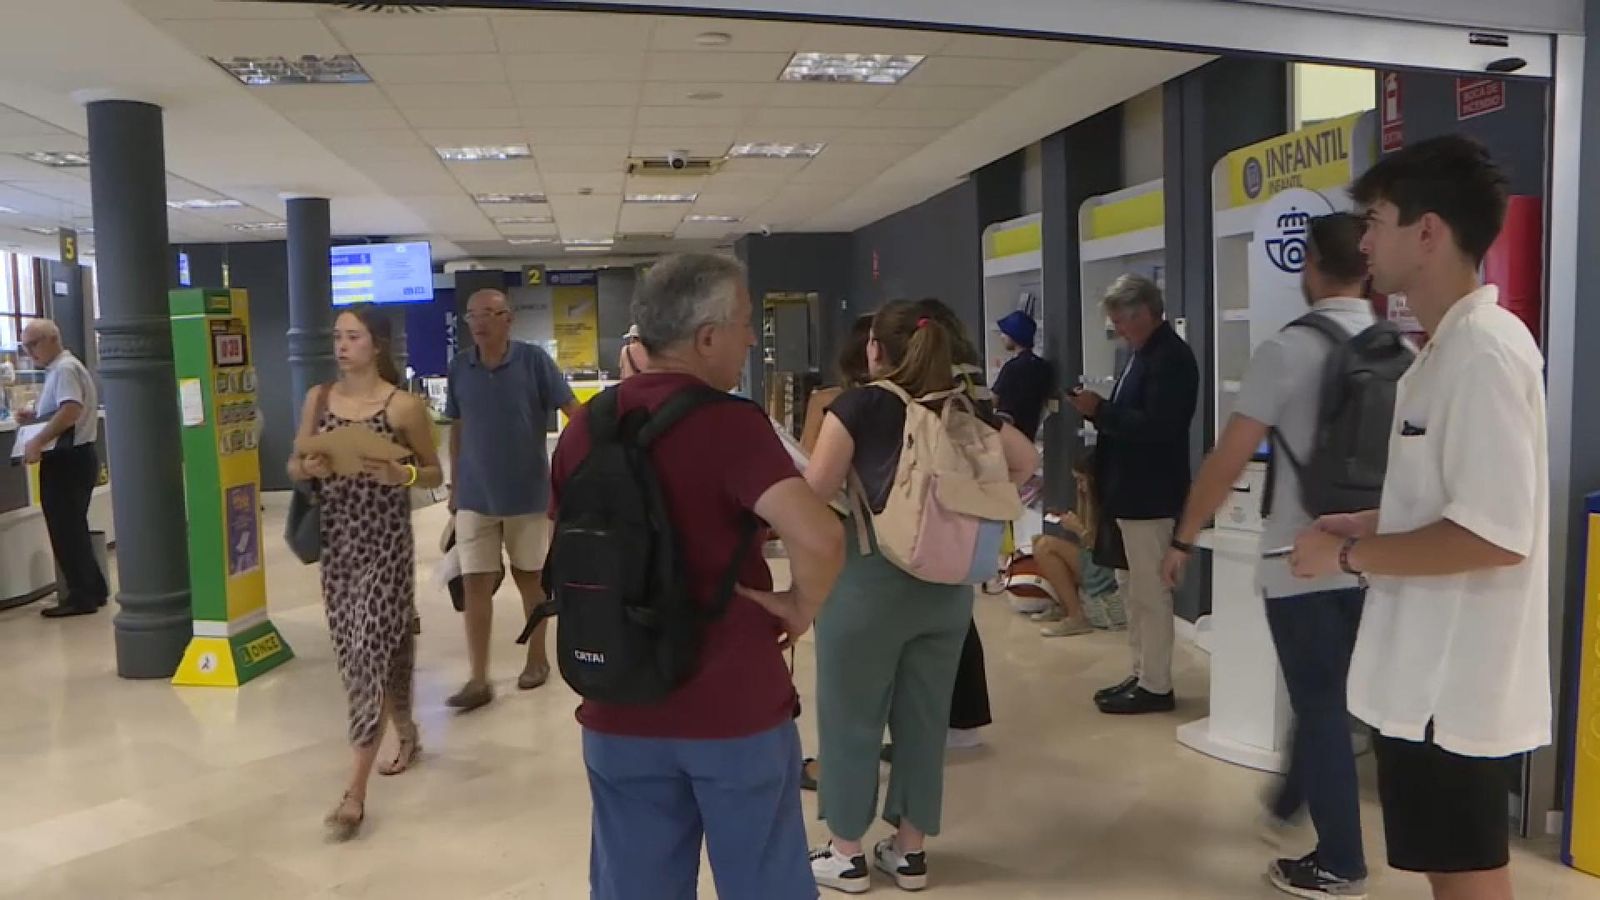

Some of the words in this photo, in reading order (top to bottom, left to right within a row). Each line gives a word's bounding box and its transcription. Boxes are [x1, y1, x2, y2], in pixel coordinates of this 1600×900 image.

[1265, 127, 1348, 177] INFANTIL
[64, 236, 75, 259] 5
[527, 269, 541, 285] 2
[250, 635, 279, 659] ONCE
